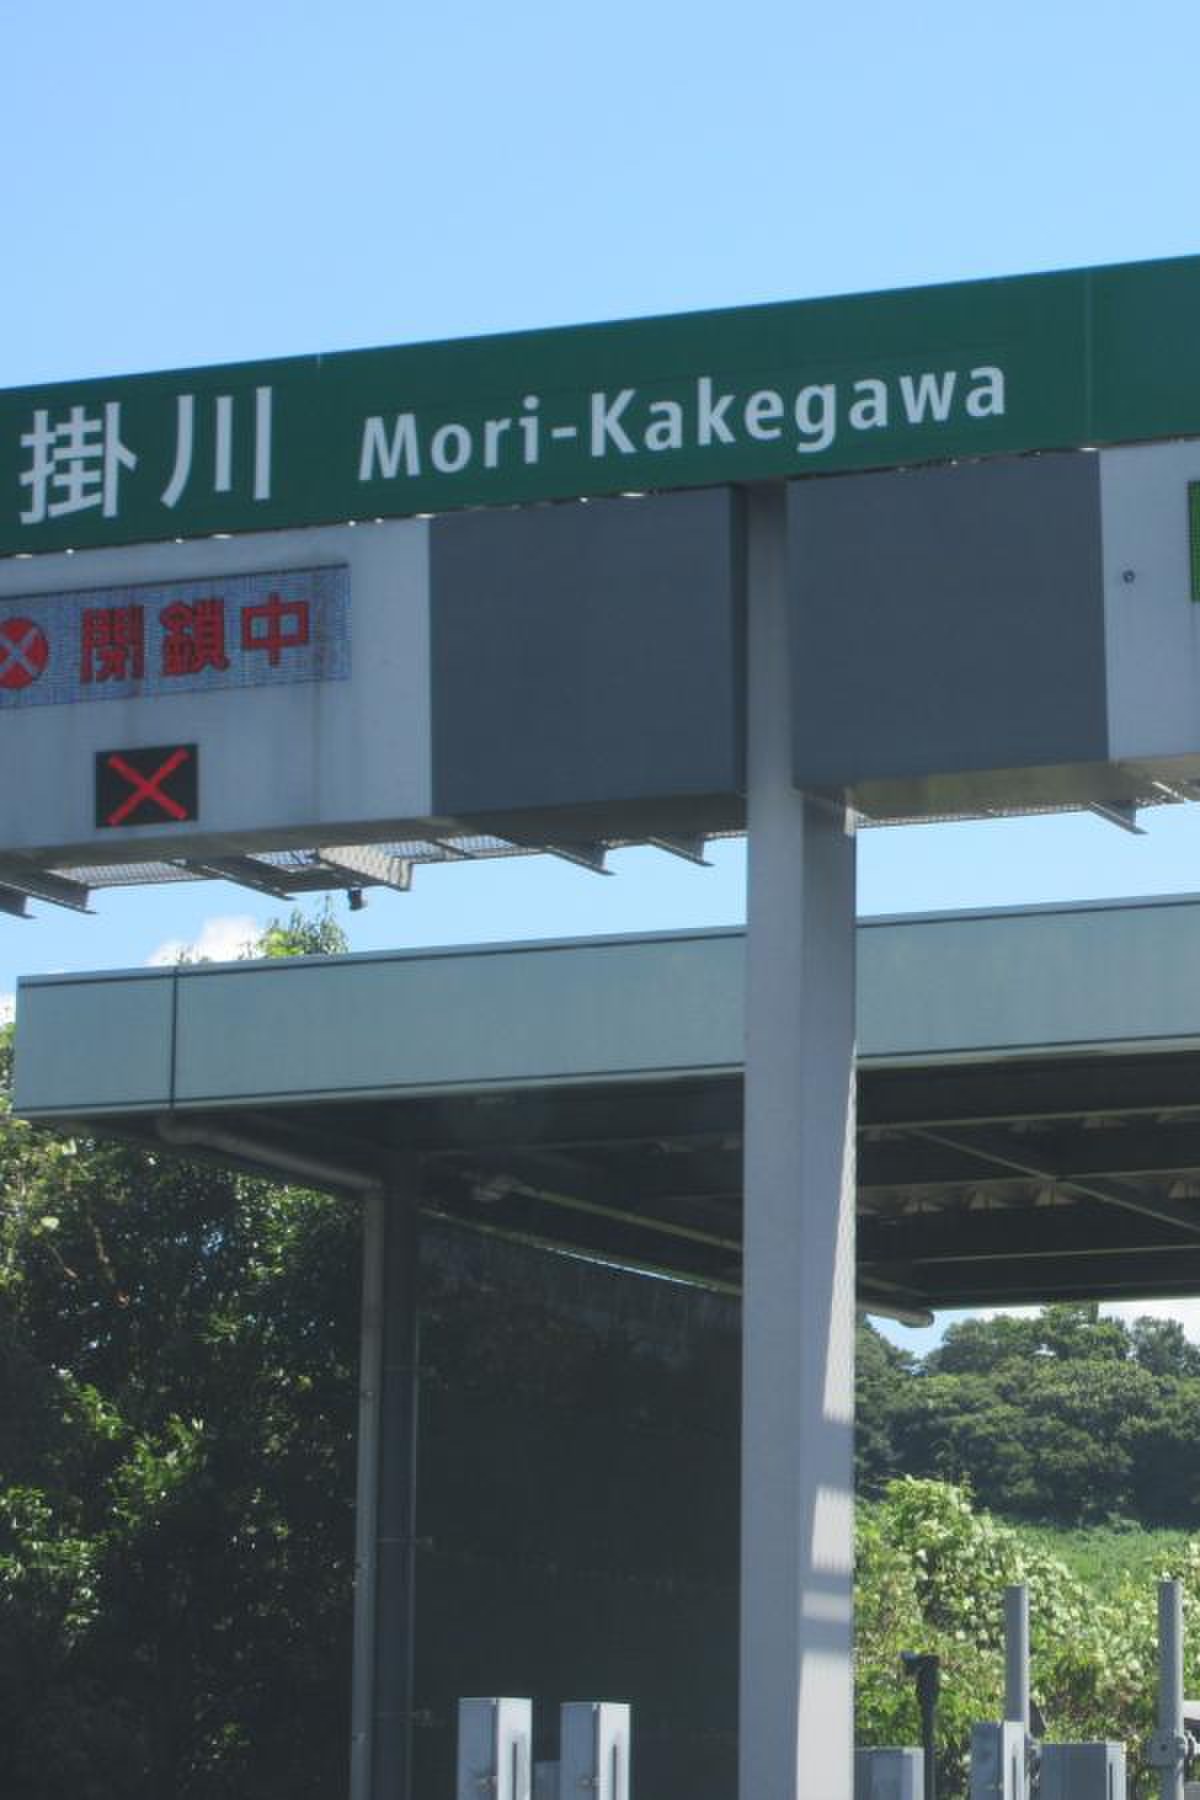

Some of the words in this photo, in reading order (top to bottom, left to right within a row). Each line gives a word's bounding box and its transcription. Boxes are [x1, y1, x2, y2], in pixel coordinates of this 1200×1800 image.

[19, 386, 273, 525] 掛川
[358, 364, 1006, 481] Mori-Kakegawa
[79, 592, 311, 685] 閉鎖中
